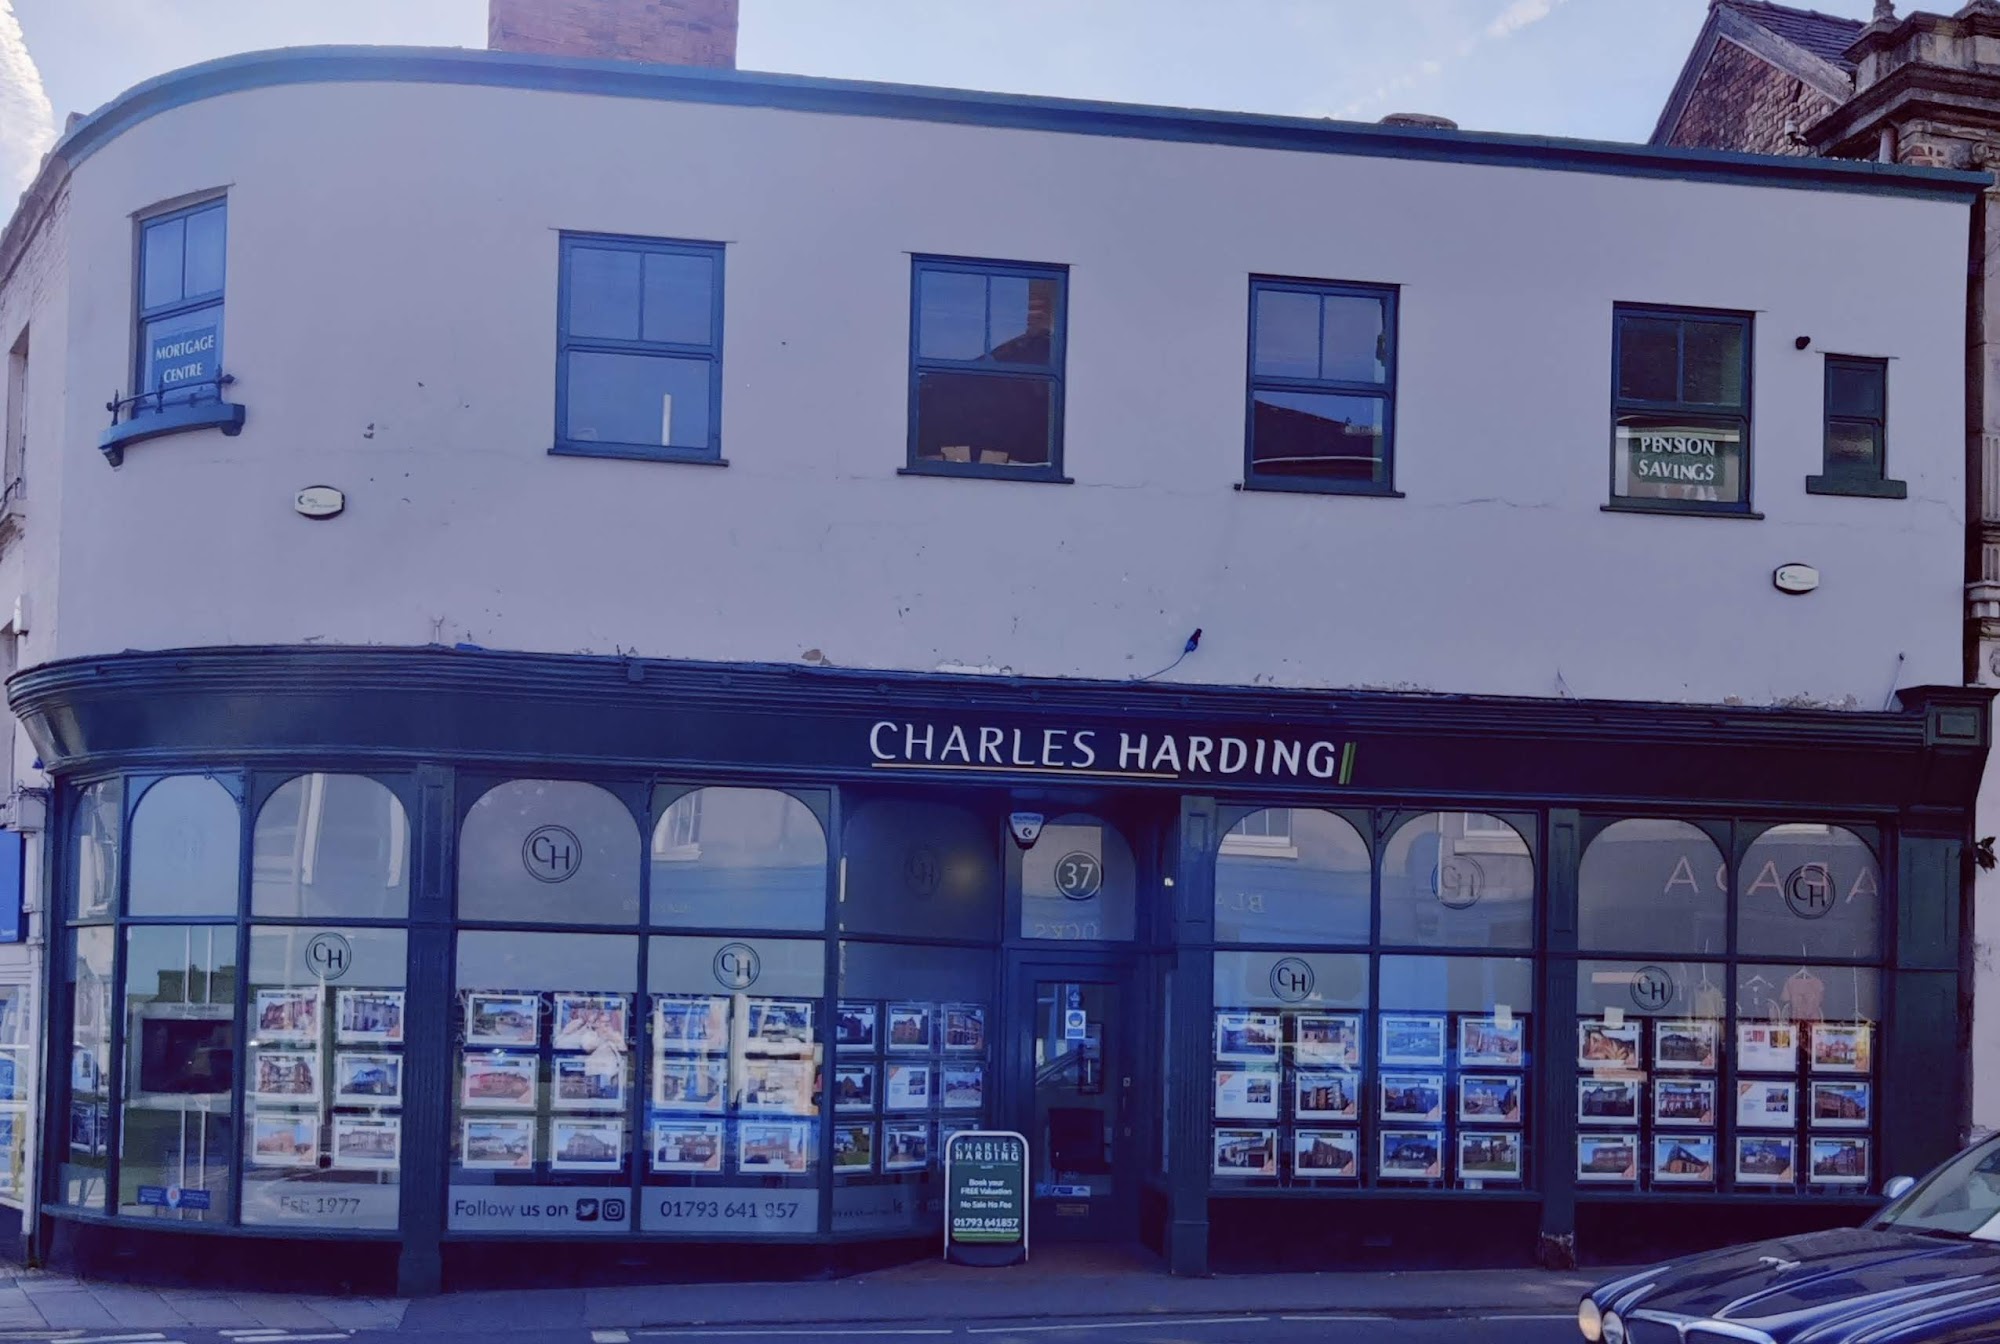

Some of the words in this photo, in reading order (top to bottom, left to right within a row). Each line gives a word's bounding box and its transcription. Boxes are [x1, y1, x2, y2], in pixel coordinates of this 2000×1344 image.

[155, 334, 214, 361] MORTGAGE
[163, 362, 203, 383] CENTRE
[1640, 436, 1715, 456] PENSION
[1638, 459, 1715, 481] SAVINGS
[869, 721, 1096, 768] CHARLES
[1118, 733, 1337, 778] HARDING
[532, 836, 570, 871] CH
[1065, 862, 1094, 889] 37
[1793, 876, 1825, 908] CH
[313, 942, 342, 969] CH
[721, 952, 751, 980] CH
[1277, 967, 1306, 993] CH
[1637, 975, 1665, 1001] CH
[955, 1142, 1019, 1152] CHARLES
[955, 1151, 1019, 1161] HARDING
[961, 1187, 979, 1195] FREE
[980, 1187, 1012, 1196] Valuation
[968, 1179, 987, 1187] Book
[317, 1197, 360, 1215] 1977
[454, 1199, 515, 1217] Follow
[520, 1204, 540, 1217] us
[546, 1204, 568, 1217] on
[660, 1201, 718, 1218] 01793
[724, 1202, 757, 1218] 641
[960, 1201, 971, 1209] No
[972, 1201, 986, 1209] Sale
[987, 1201, 998, 1209] No
[999, 1201, 1012, 1209] Fee
[953, 1218, 982, 1227] 01793
[984, 1218, 1019, 1227] 641857
